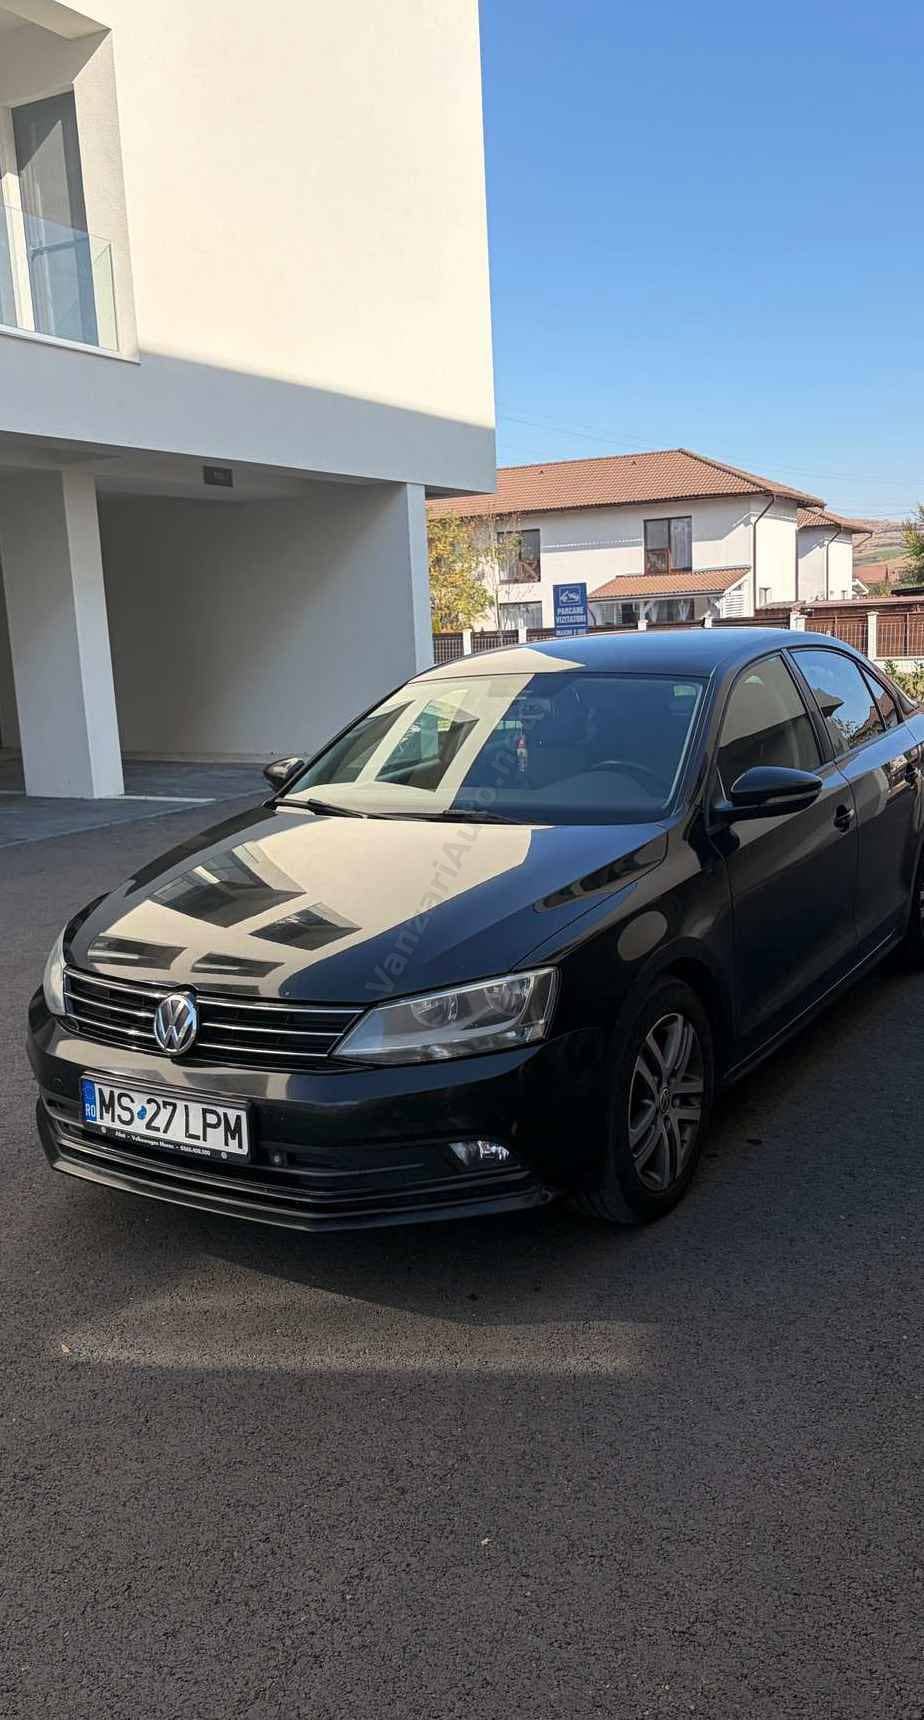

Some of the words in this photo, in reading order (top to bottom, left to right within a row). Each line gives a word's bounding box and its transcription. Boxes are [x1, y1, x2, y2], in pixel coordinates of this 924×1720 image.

[85, 1104, 96, 1117] RO
[98, 1088, 135, 1126] MS
[144, 1098, 177, 1134] 27
[184, 1104, 243, 1149] LPM
